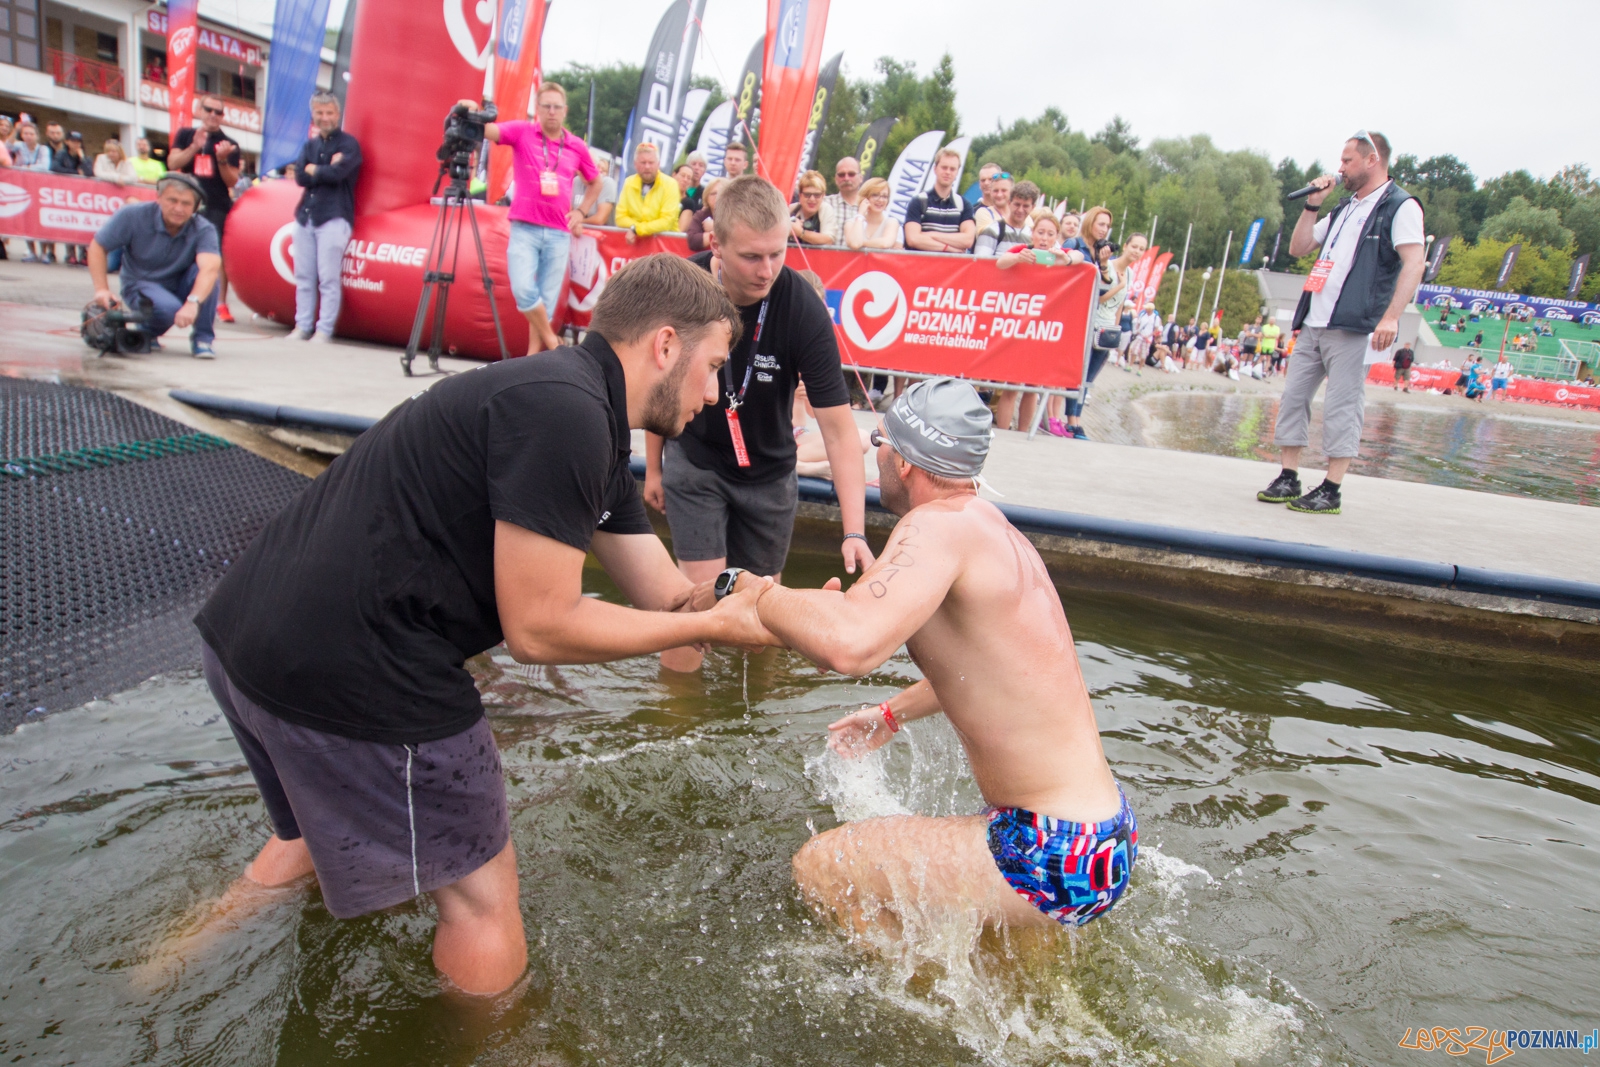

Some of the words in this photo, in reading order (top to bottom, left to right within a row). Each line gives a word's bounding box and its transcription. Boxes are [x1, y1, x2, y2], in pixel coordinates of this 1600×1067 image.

[808, 87, 828, 130] ROO
[39, 187, 125, 212] SELGRO
[344, 239, 427, 267] ALLENGE
[912, 286, 1047, 316] CHALLENGE
[1545, 310, 1574, 320] Enea
[906, 310, 976, 334] POZNAŃ
[990, 317, 1064, 342] POLAND
[900, 404, 958, 448] FINIS
